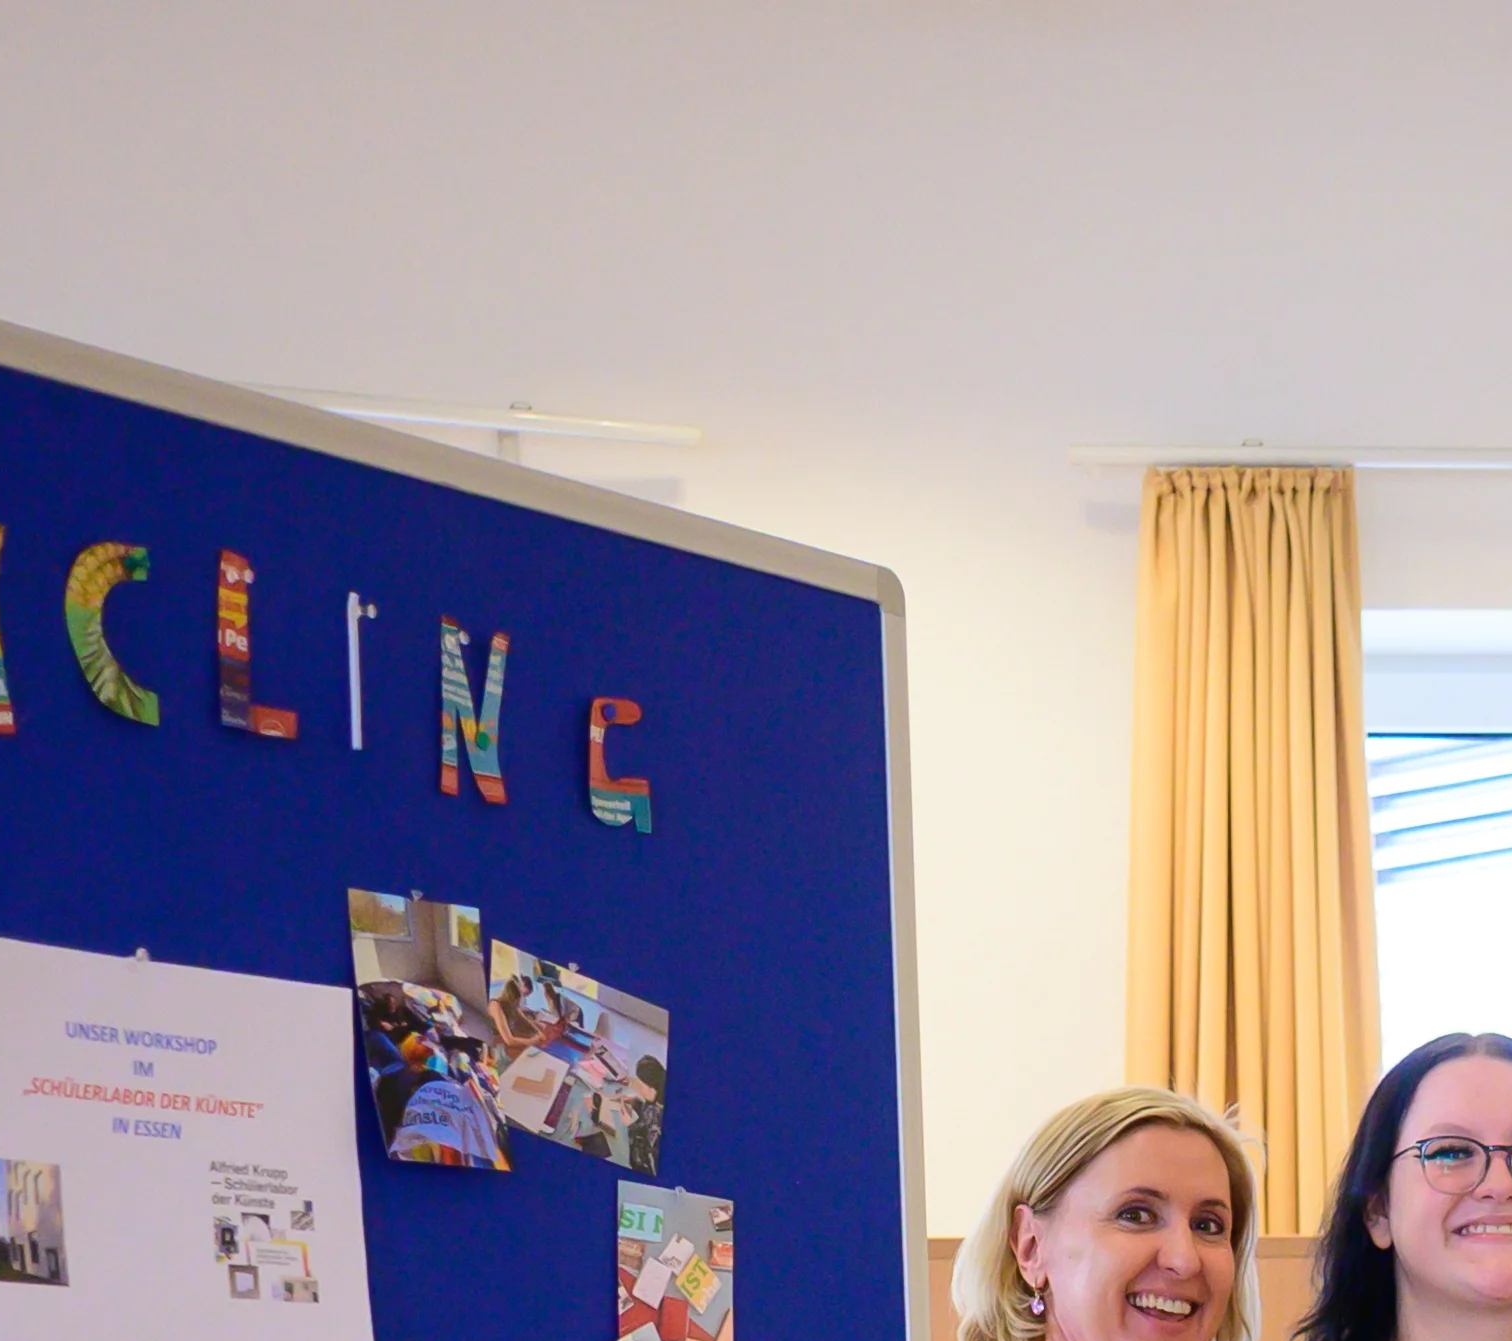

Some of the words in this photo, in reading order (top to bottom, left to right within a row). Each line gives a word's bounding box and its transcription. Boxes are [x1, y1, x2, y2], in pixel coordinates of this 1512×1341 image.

[65, 1020, 121, 1046] UNSER
[124, 1028, 218, 1055] WORKSHOP
[132, 1060, 155, 1078] IM
[160, 1093, 191, 1112] DER
[112, 1117, 130, 1135] IN
[134, 1119, 182, 1140] ESSEN
